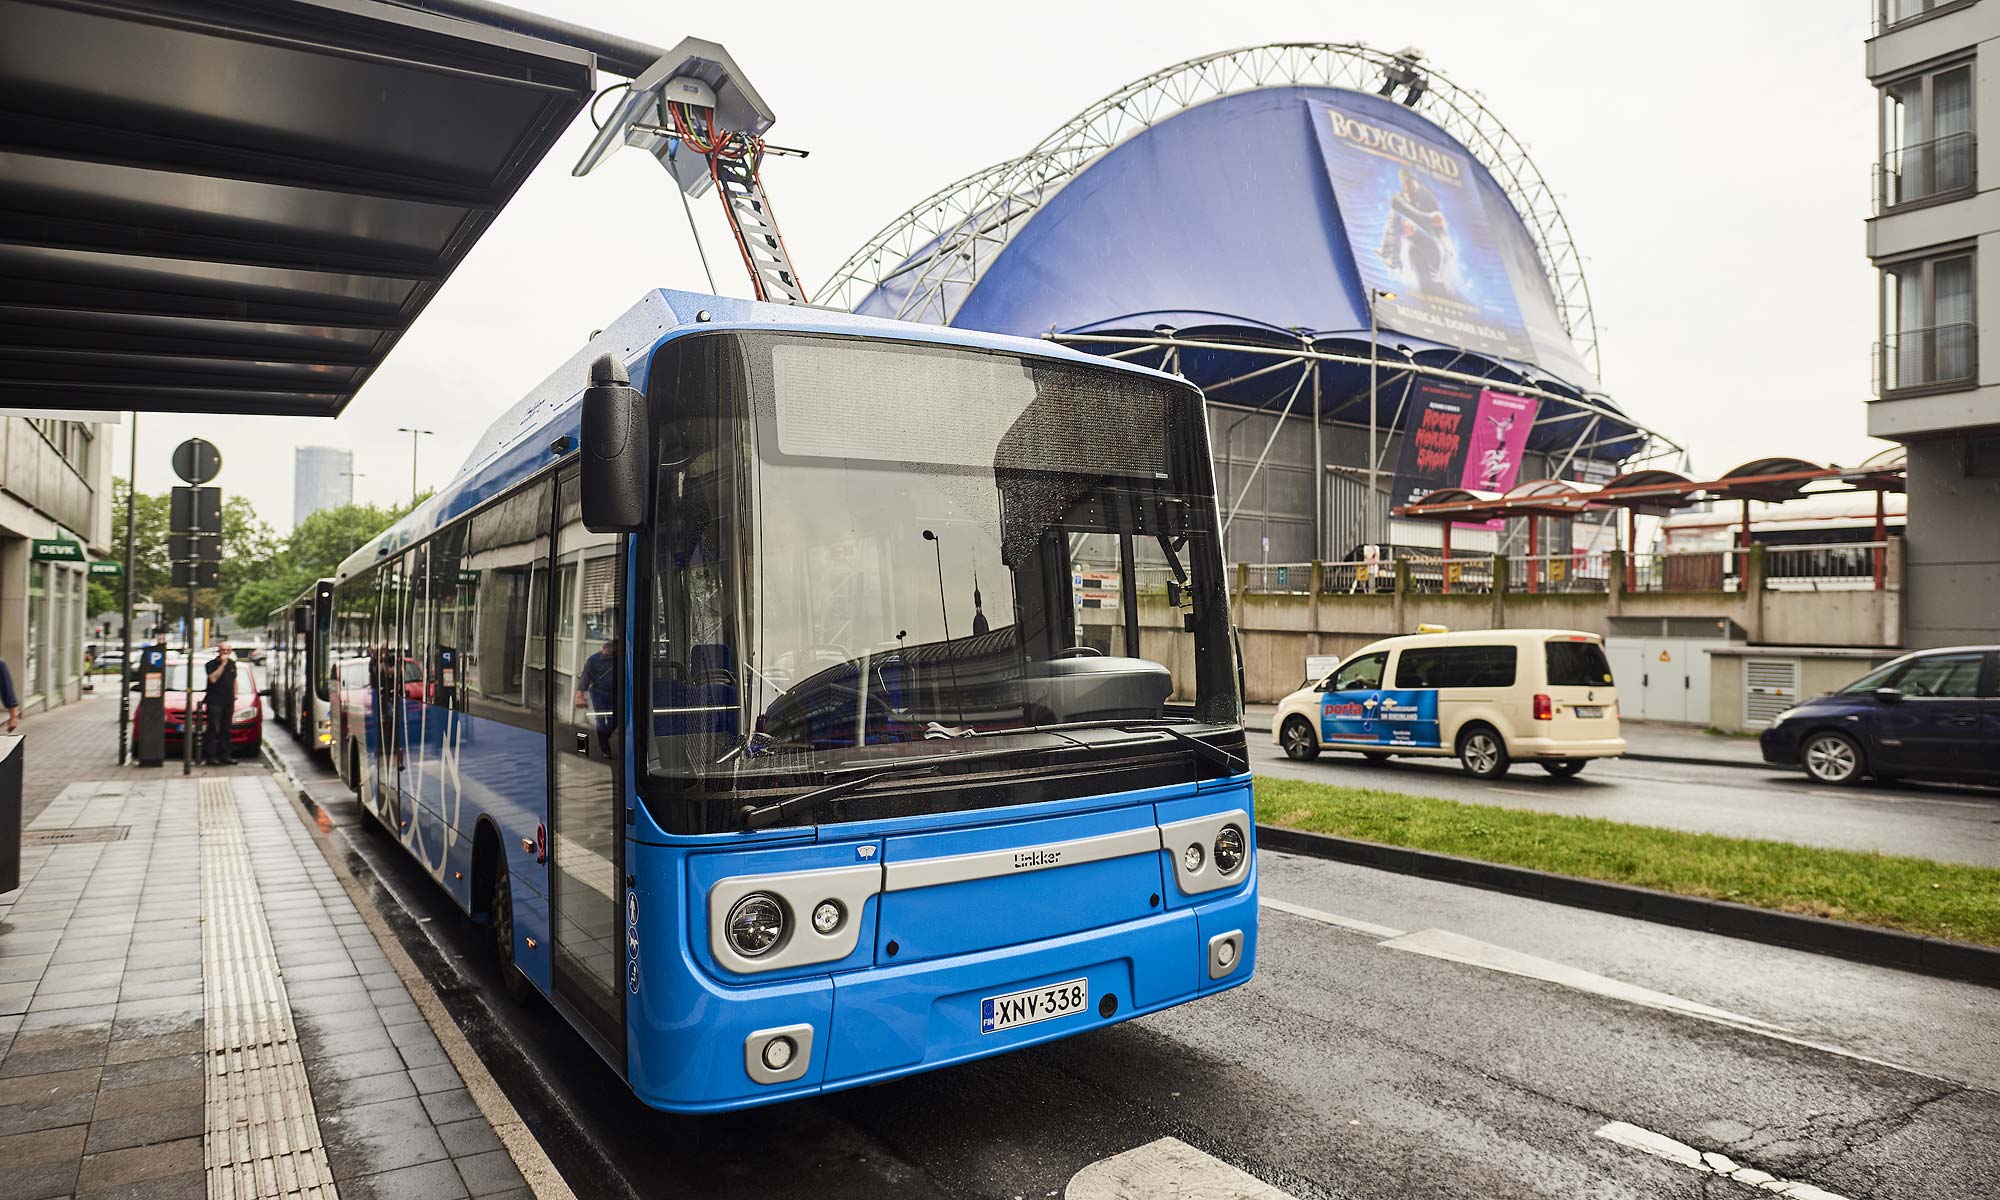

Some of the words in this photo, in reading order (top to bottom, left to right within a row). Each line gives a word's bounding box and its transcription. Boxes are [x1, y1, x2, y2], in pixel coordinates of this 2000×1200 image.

[1328, 109, 1459, 177] BODYGUARD
[1422, 408, 1462, 434] ROCKY
[1415, 427, 1460, 456] HORROR
[1417, 448, 1452, 473] SHOW
[39, 545, 75, 555] DEVK
[151, 651, 162, 665] P
[1324, 702, 1363, 716] porta
[1014, 851, 1061, 868] Linkker
[1000, 986, 1082, 1025] XNV-338
[983, 1017, 994, 1027] FIN
